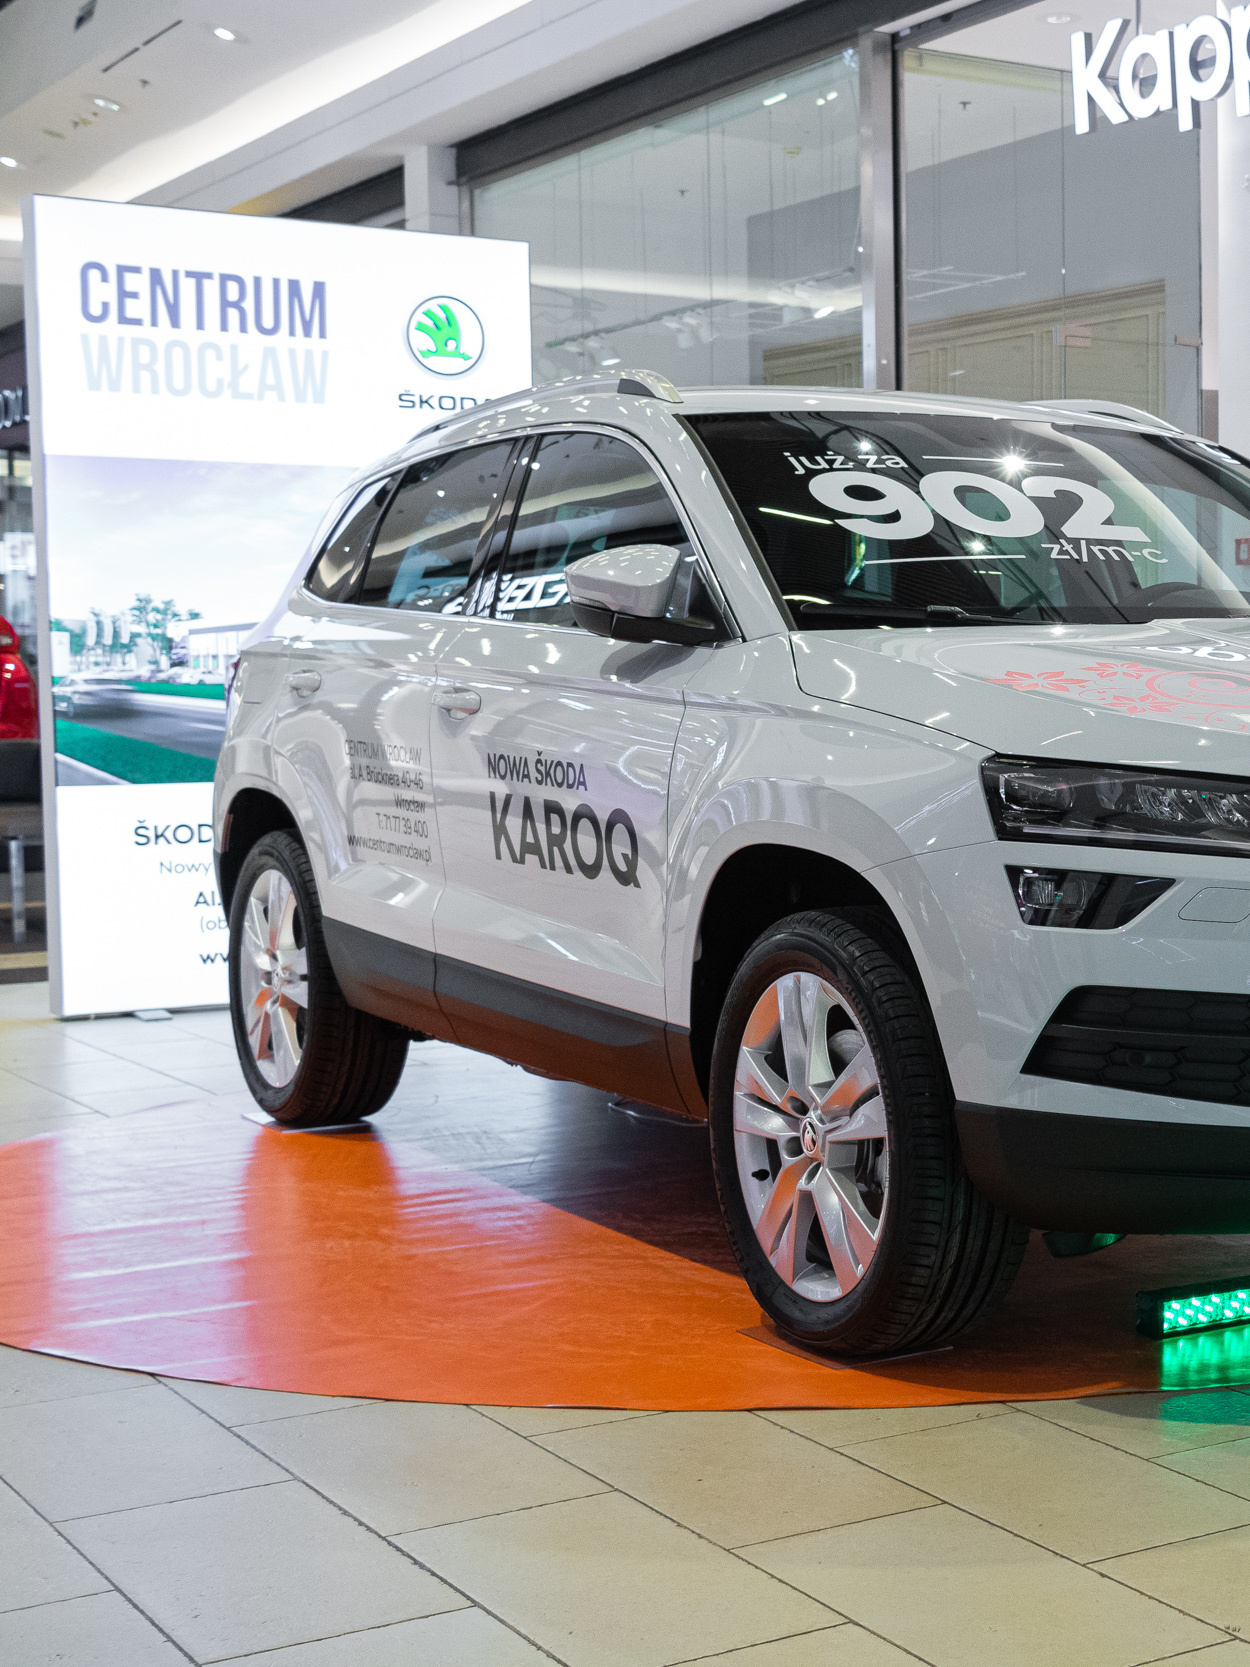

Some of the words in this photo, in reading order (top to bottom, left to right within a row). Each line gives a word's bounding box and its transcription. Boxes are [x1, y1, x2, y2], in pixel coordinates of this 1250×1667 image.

[80, 261, 327, 340] CENTRUM
[80, 333, 329, 405] WROCŁAW
[398, 390, 492, 411] ŠKOD
[783, 451, 854, 475] już
[857, 455, 909, 469] za
[808, 470, 1152, 543] 902
[1040, 539, 1169, 565] zł/m-c
[345, 739, 380, 761] CENTRUM
[366, 765, 401, 787] Brücknera
[401, 770, 424, 790] 40-46
[487, 752, 532, 784] NOWA
[535, 750, 588, 791] ŠKODA
[393, 793, 426, 814] Wrocław
[134, 820, 213, 846] ŠKOD
[383, 814, 393, 831] 71
[402, 817, 412, 835] 39
[413, 819, 429, 839] 400
[489, 790, 642, 889] KAROQ
[159, 860, 212, 876] Nowy
[194, 890, 222, 907] Al.
[200, 916, 230, 933] (ob
